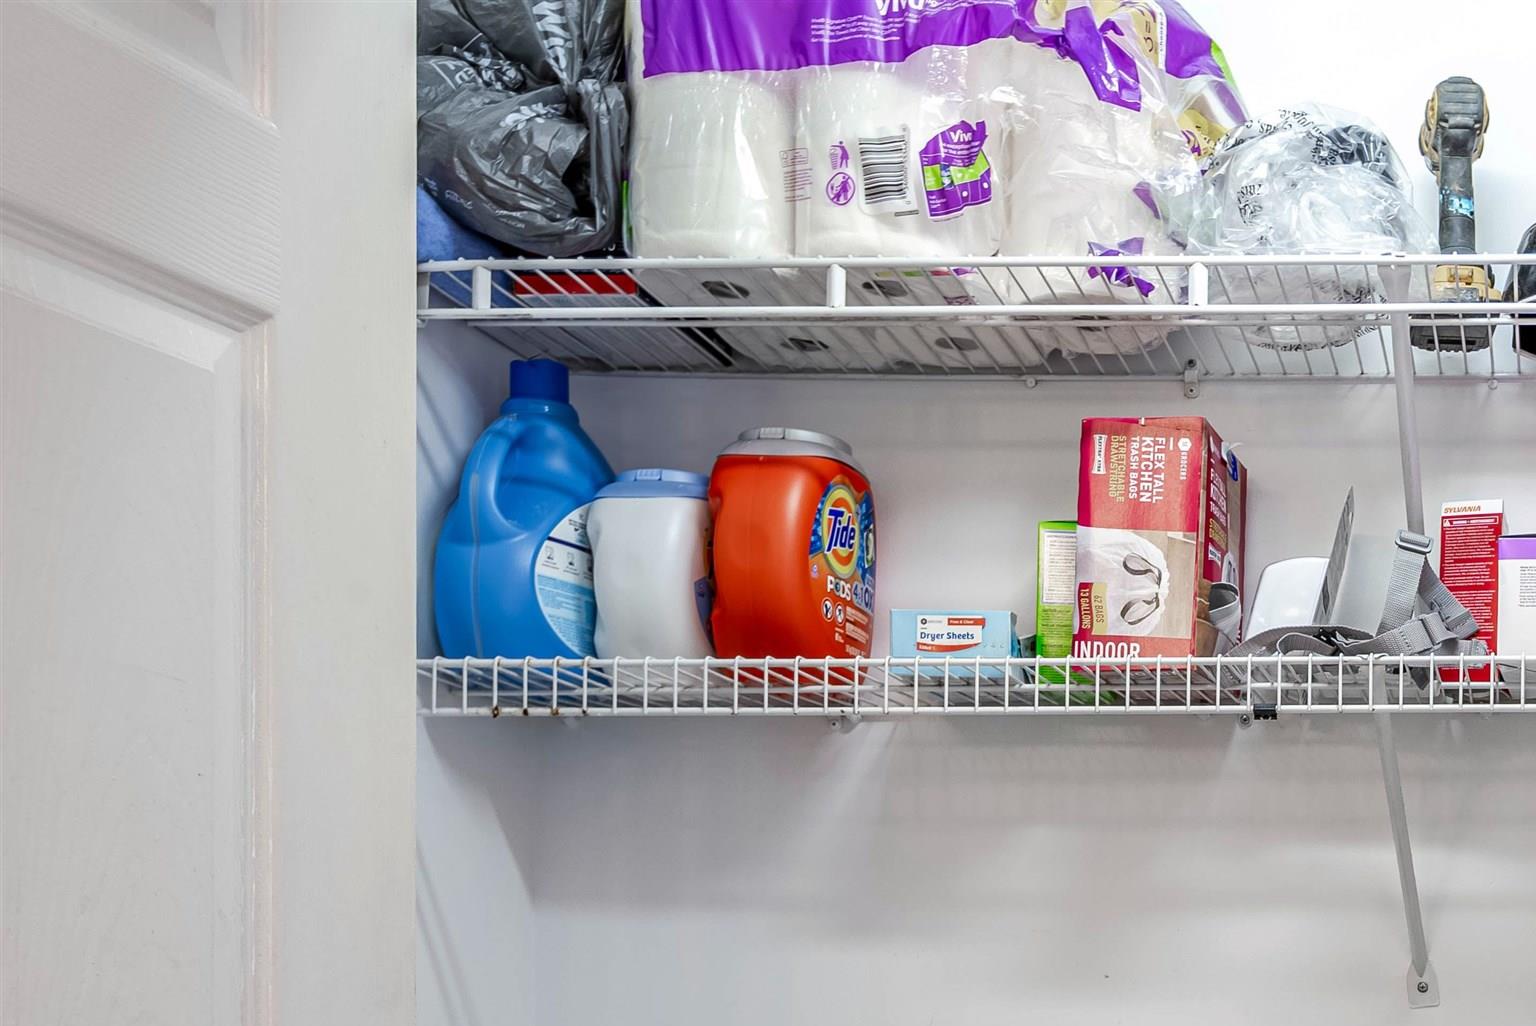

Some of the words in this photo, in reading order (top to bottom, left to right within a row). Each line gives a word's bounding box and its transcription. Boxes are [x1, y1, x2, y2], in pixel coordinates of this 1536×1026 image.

[1108, 435, 1119, 497] DRAWSTRING
[1129, 435, 1140, 469] TRASH
[1154, 437, 1166, 469] FLEX
[1116, 435, 1127, 502] STRETCHABLE
[1139, 436, 1154, 503] KITCHEN
[1128, 472, 1138, 499] BAGS
[1152, 472, 1165, 503] TALL
[1443, 505, 1481, 513] SYLVANIA
[824, 507, 857, 554] Tide
[1080, 588, 1089, 597] 13
[920, 631, 945, 642] Dryer
[946, 631, 975, 640] Sheets
[1074, 640, 1141, 658] INDOOR
